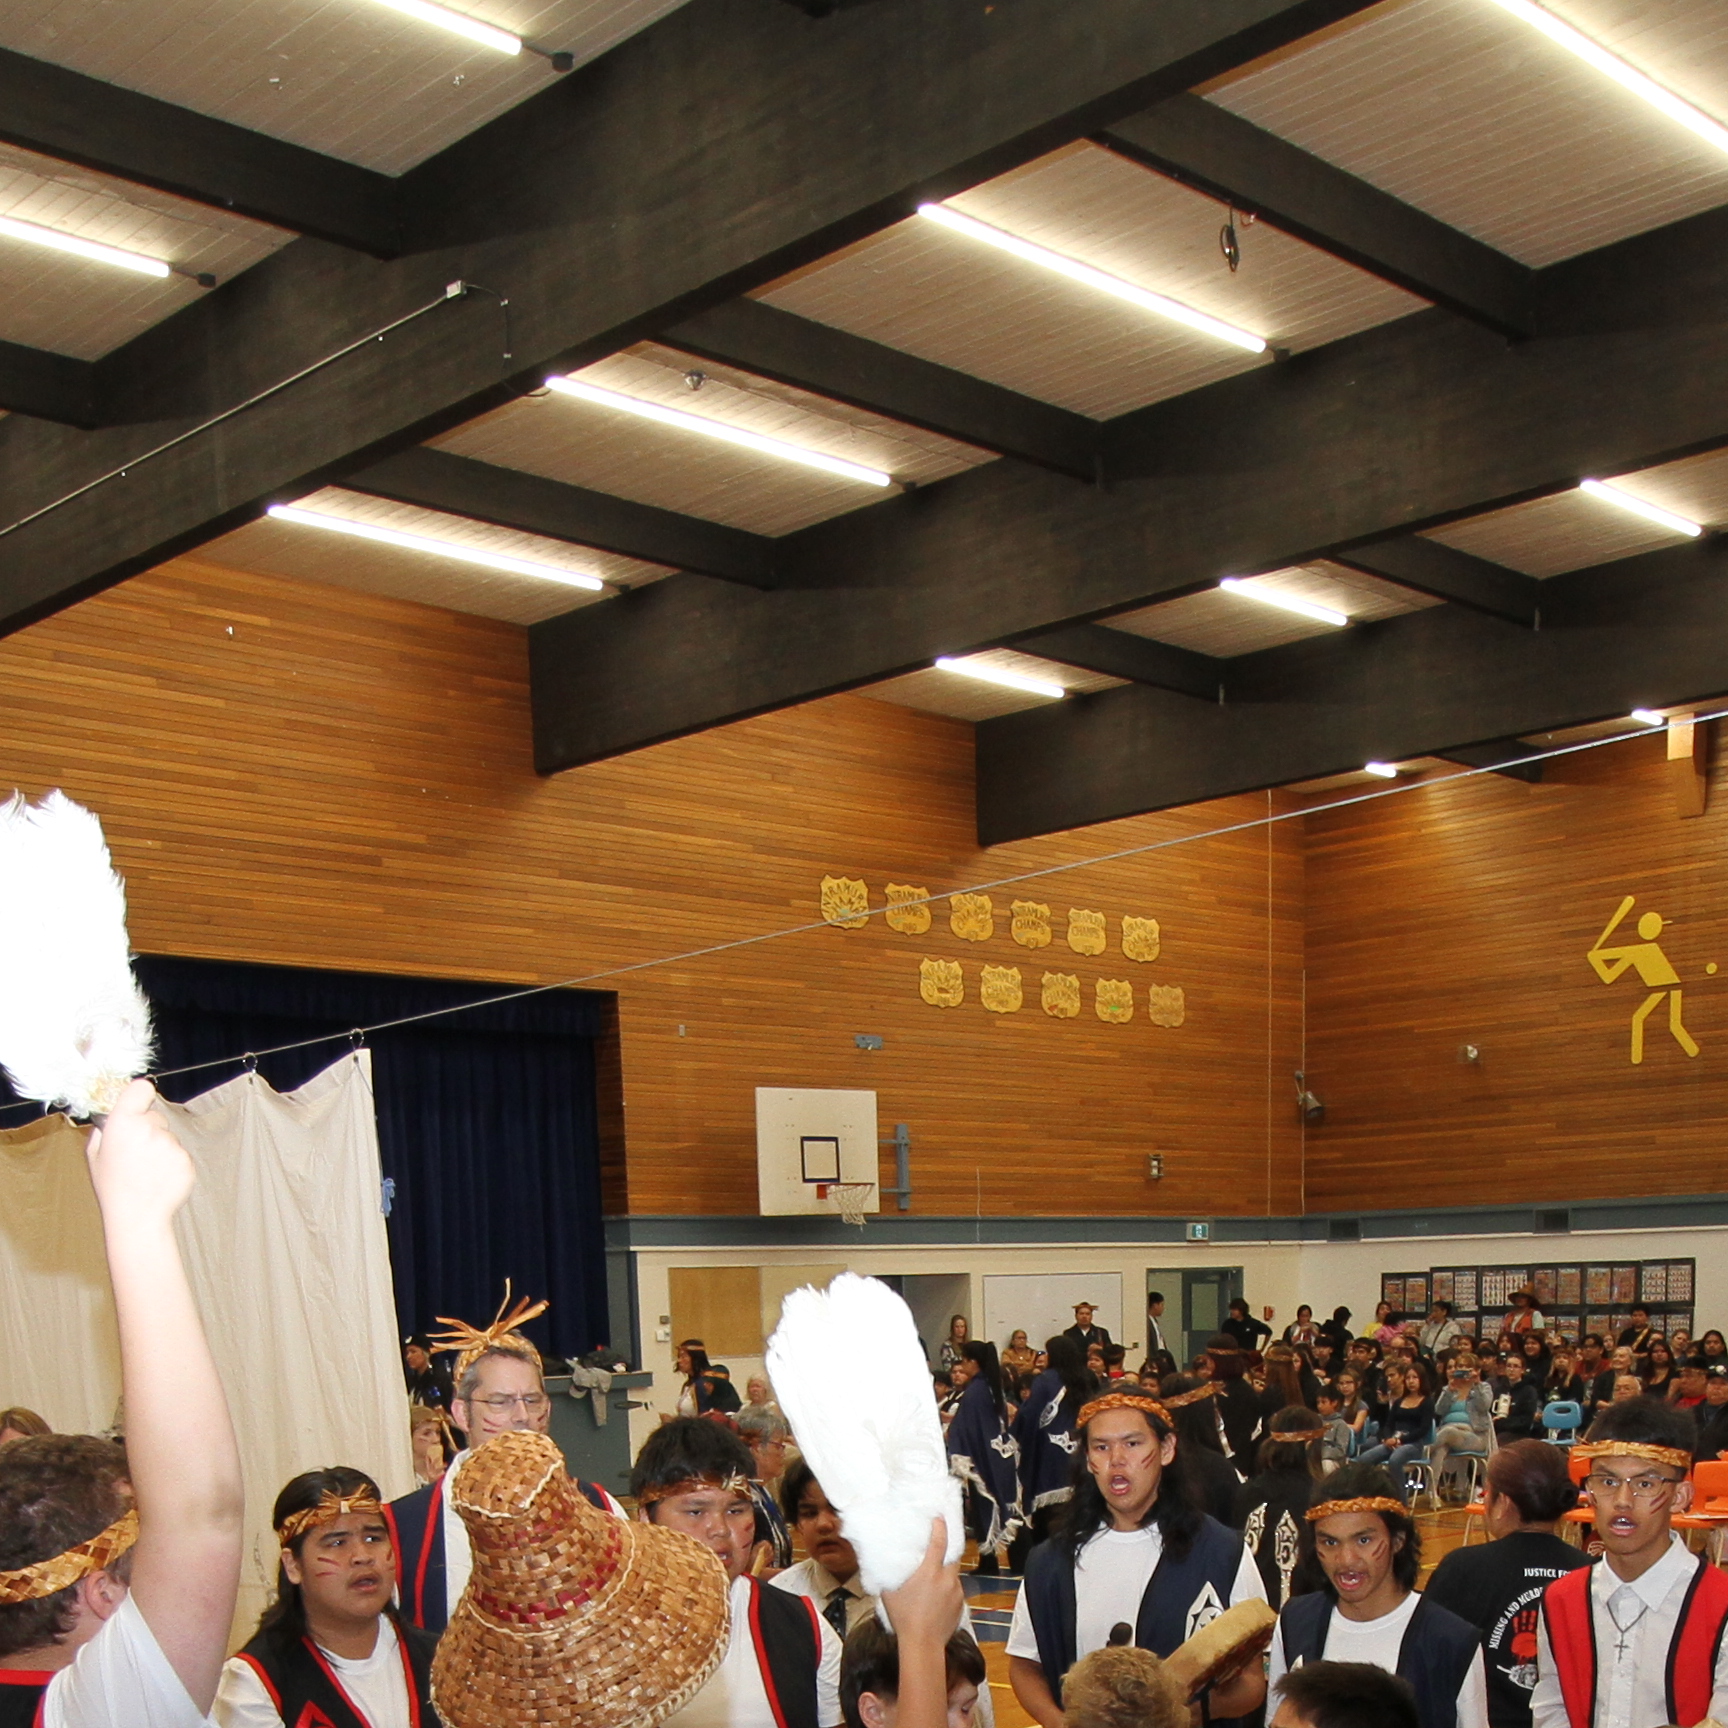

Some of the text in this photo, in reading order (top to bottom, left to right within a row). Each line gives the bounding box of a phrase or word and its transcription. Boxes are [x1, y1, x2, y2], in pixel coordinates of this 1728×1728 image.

[1524, 1567, 1557, 1578] JUSTICE
[1488, 1616, 1509, 1650] MISSING
[1503, 1600, 1520, 1619] AND
